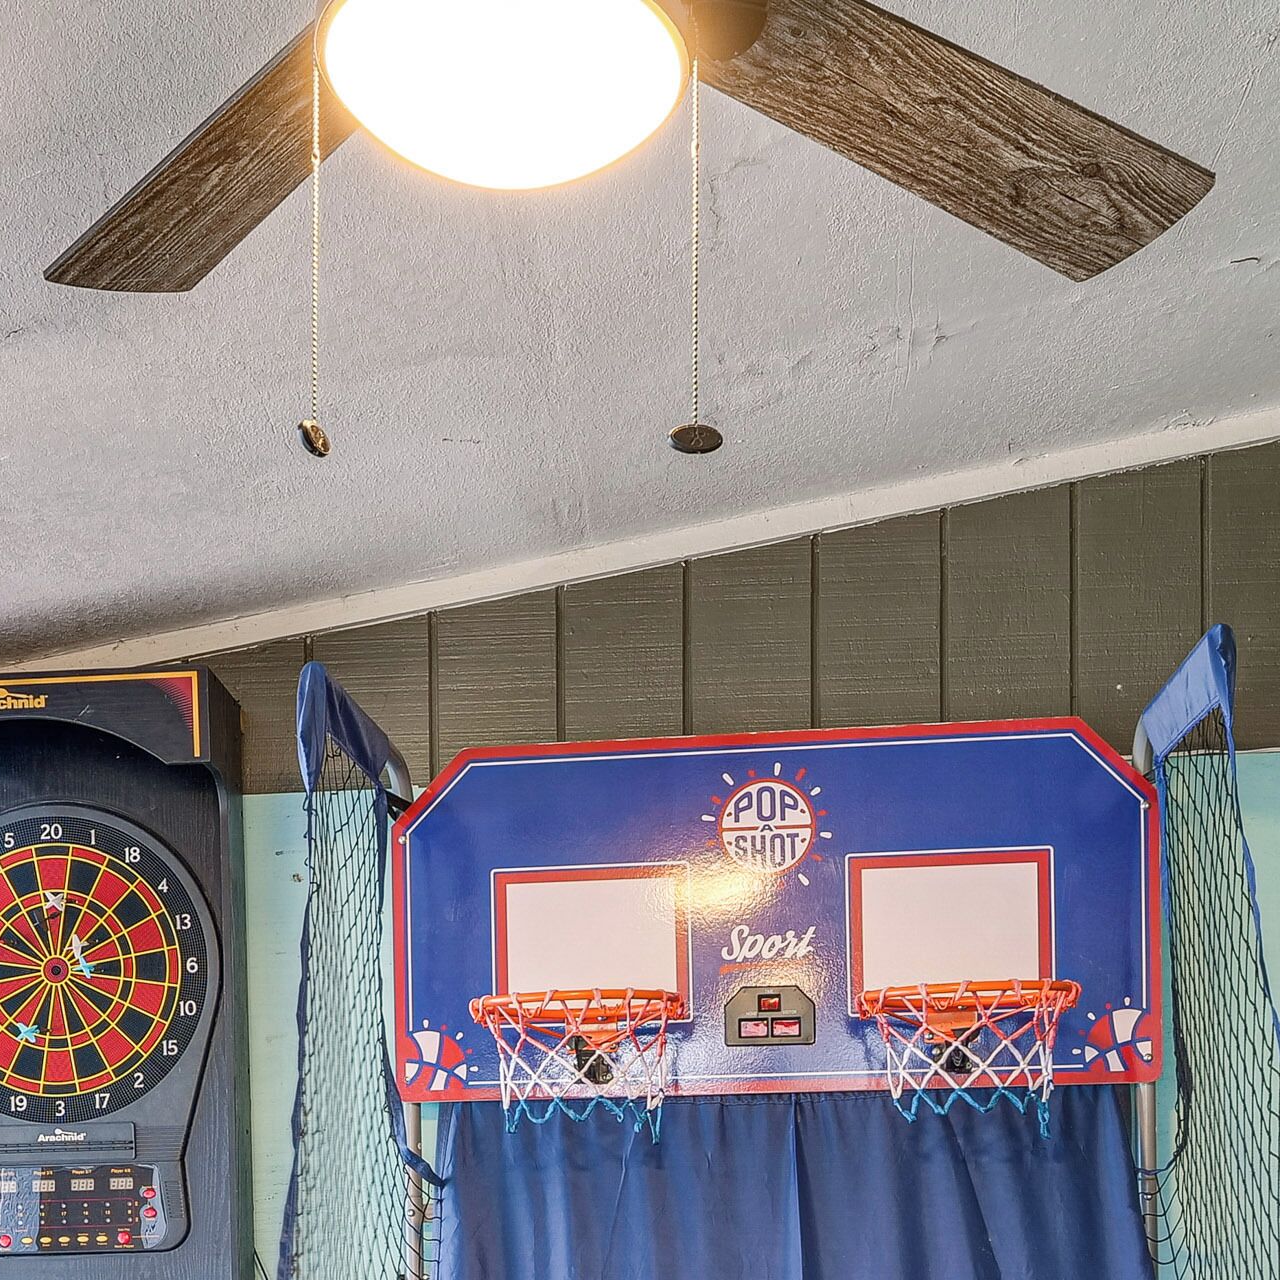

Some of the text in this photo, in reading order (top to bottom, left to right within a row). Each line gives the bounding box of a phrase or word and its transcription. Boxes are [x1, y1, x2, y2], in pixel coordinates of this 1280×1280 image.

[733, 786, 799, 823] POP
[4, 832, 15, 848] 5
[40, 824, 63, 840] 20
[89, 830, 96, 846] 1
[124, 847, 141, 863] 18
[734, 832, 800, 866] SHOT
[158, 878, 169, 894] 4
[175, 914, 191, 931] 13
[721, 924, 817, 962] Sport
[186, 957, 198, 973] 6
[178, 1001, 197, 1016] 10
[162, 1040, 178, 1056] 15
[133, 1073, 144, 1088] 2
[10, 1096, 27, 1112] 19
[55, 1101, 65, 1116] 3
[94, 1093, 111, 1109] 17
[37, 1131, 86, 1142] Arachnid
